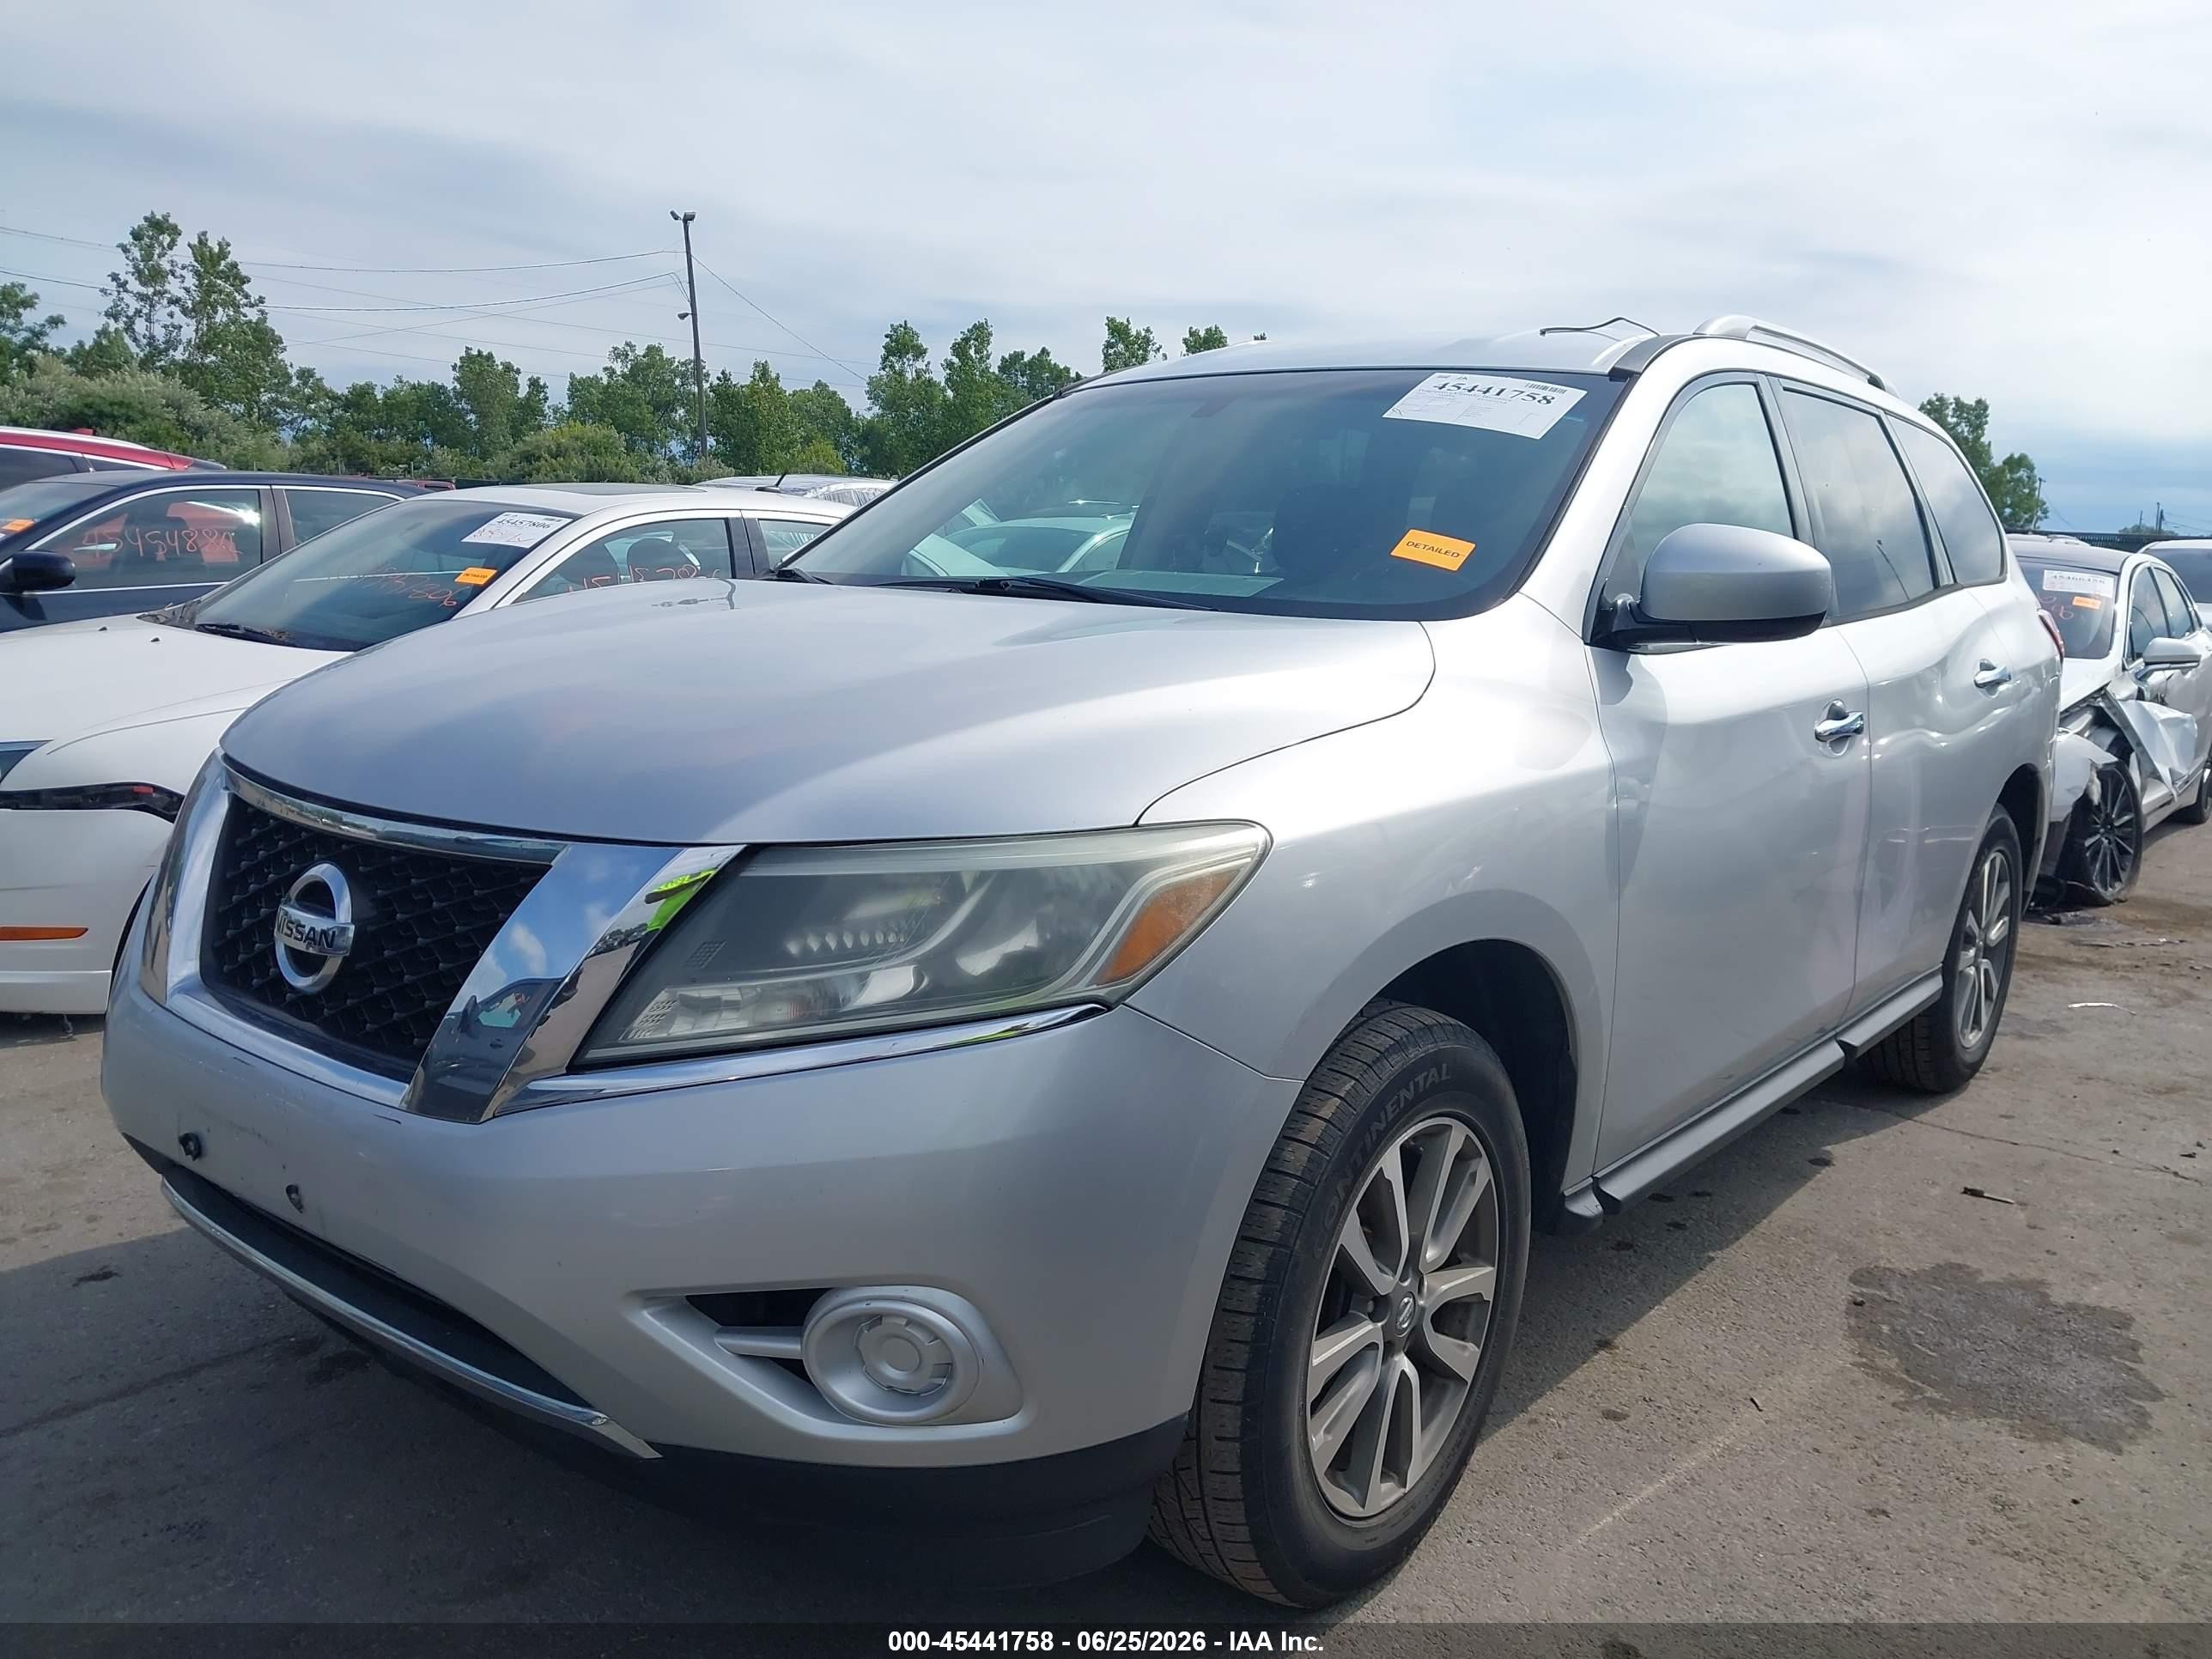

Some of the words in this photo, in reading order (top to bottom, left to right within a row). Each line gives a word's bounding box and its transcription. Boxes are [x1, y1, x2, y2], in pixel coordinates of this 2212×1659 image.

[1432, 380, 1556, 405] 45441758
[1406, 540, 1461, 558] DETAILED
[276, 906, 337, 949] NISSAN
[1317, 1062, 1453, 1254] CONTINENTAL
